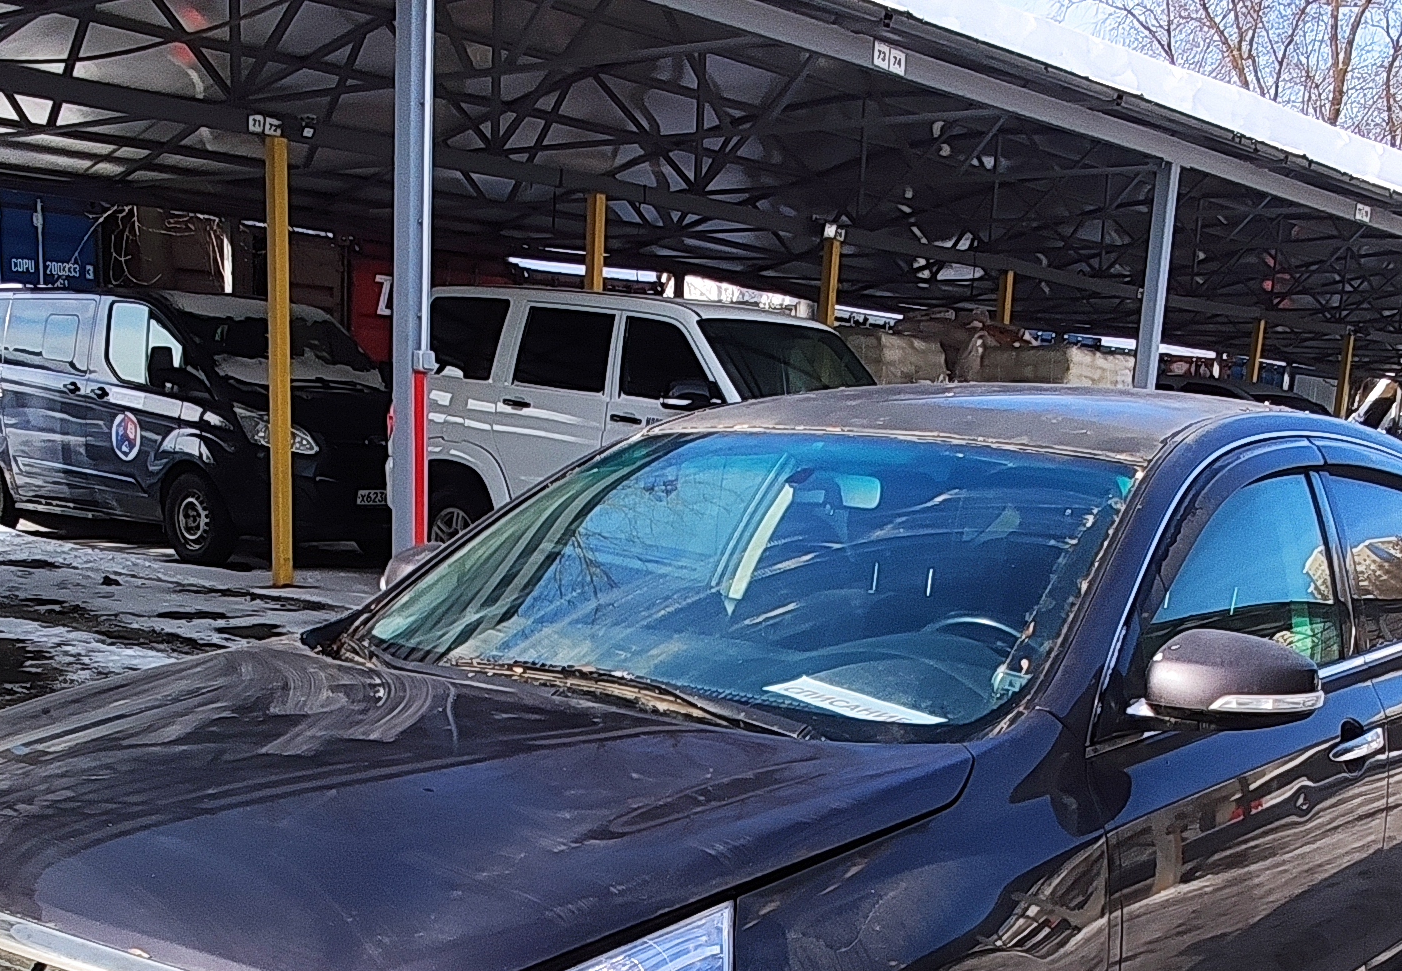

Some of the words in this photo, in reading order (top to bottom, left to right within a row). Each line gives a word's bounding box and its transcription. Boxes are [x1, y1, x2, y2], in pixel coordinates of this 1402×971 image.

[877, 49, 887, 62] 73
[892, 56, 902, 68] 74
[11, 259, 35, 273] COPU
[359, 491, 387, 504] Х623
